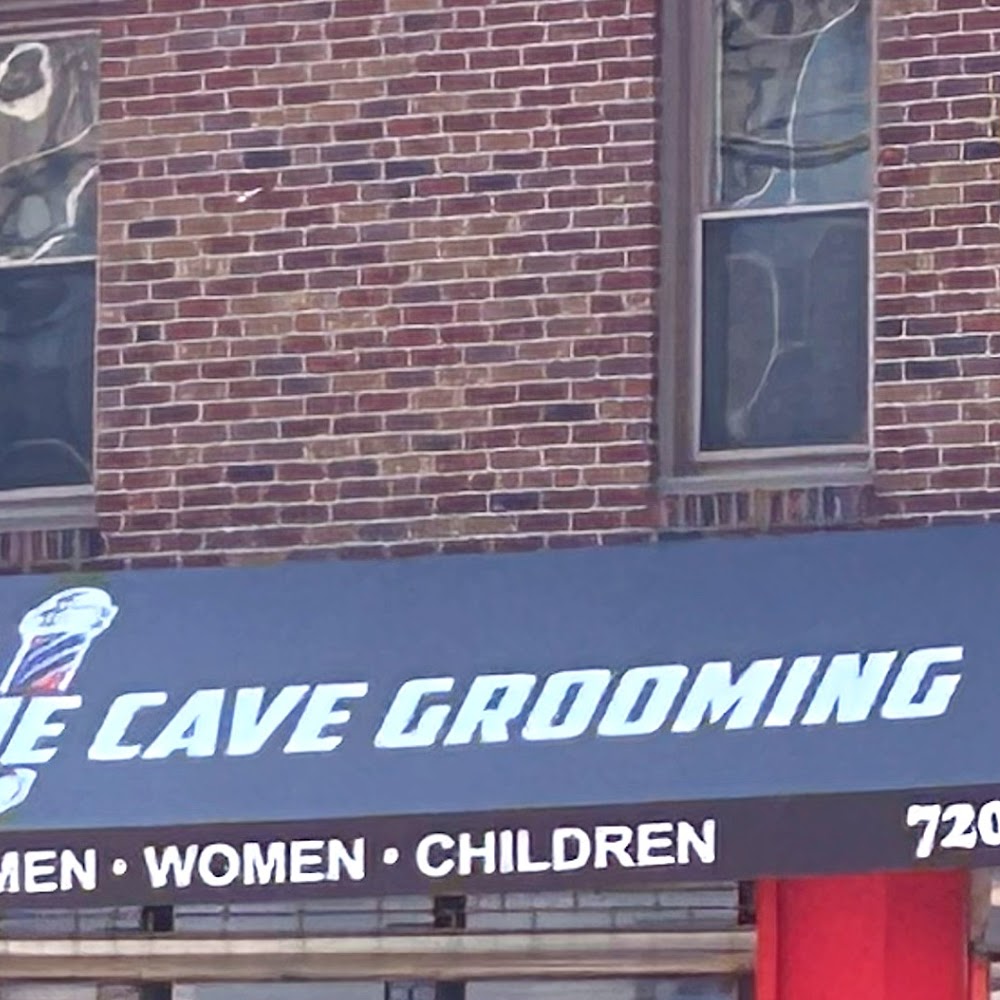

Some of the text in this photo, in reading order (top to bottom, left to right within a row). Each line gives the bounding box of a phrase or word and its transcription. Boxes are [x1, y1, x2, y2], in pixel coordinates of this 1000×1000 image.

[88, 681, 369, 761] CAVE
[374, 645, 964, 749] GROOMING
[143, 837, 366, 890] WOMEN
[416, 818, 718, 878] CHILDREN
